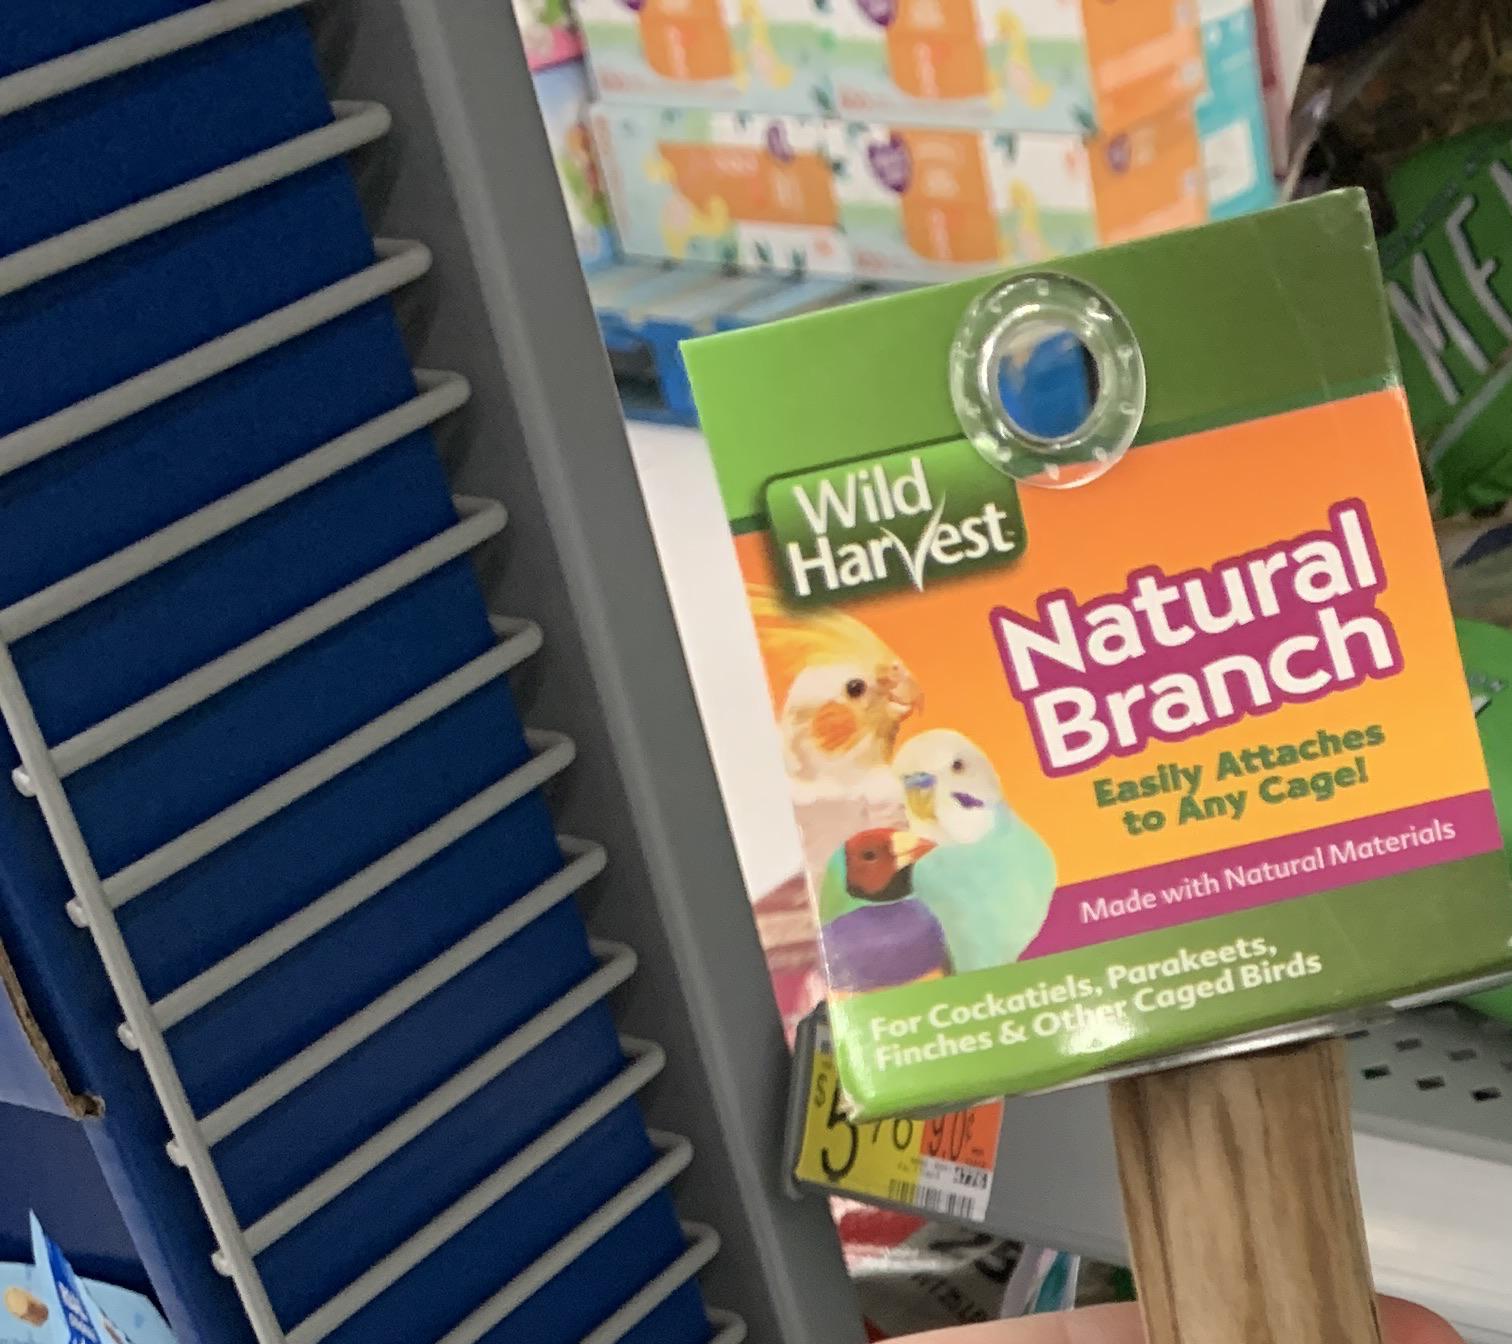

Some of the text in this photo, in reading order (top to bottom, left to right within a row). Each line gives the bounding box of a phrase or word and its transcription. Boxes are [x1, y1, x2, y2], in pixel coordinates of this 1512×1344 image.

[793, 456, 932, 536] Wild
[1000, 508, 1378, 692] Natural
[1033, 606, 1395, 769] Branch
[1093, 724, 1386, 808] Easily Attaches
[1122, 756, 1370, 836] to Any Cage!
[1080, 819, 1457, 924] Made with Natural Materials
[869, 934, 1278, 1042] For Cockatiels, Parakeets,
[873, 951, 1324, 1072] Finches & Other Caged Birds
